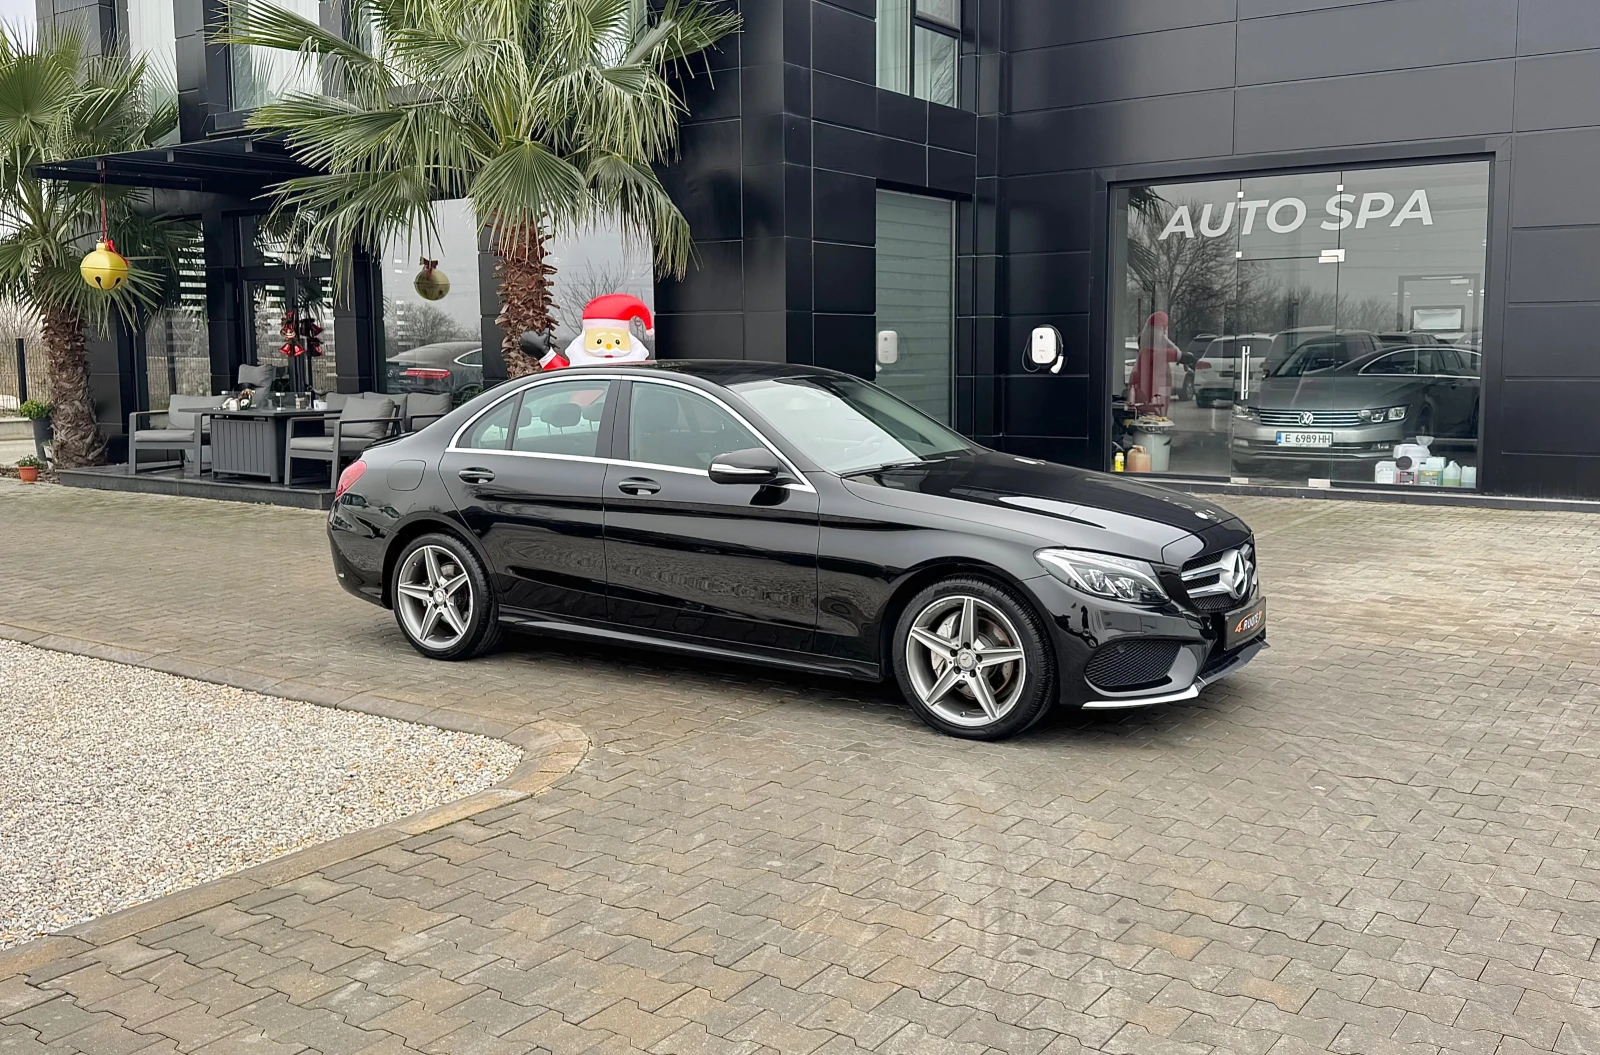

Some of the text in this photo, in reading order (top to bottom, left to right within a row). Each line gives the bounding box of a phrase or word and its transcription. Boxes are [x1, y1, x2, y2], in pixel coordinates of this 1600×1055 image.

[1158, 189, 1433, 240] AUTO SPA
[1285, 434, 1291, 443] E
[1295, 434, 1317, 444] 6989
